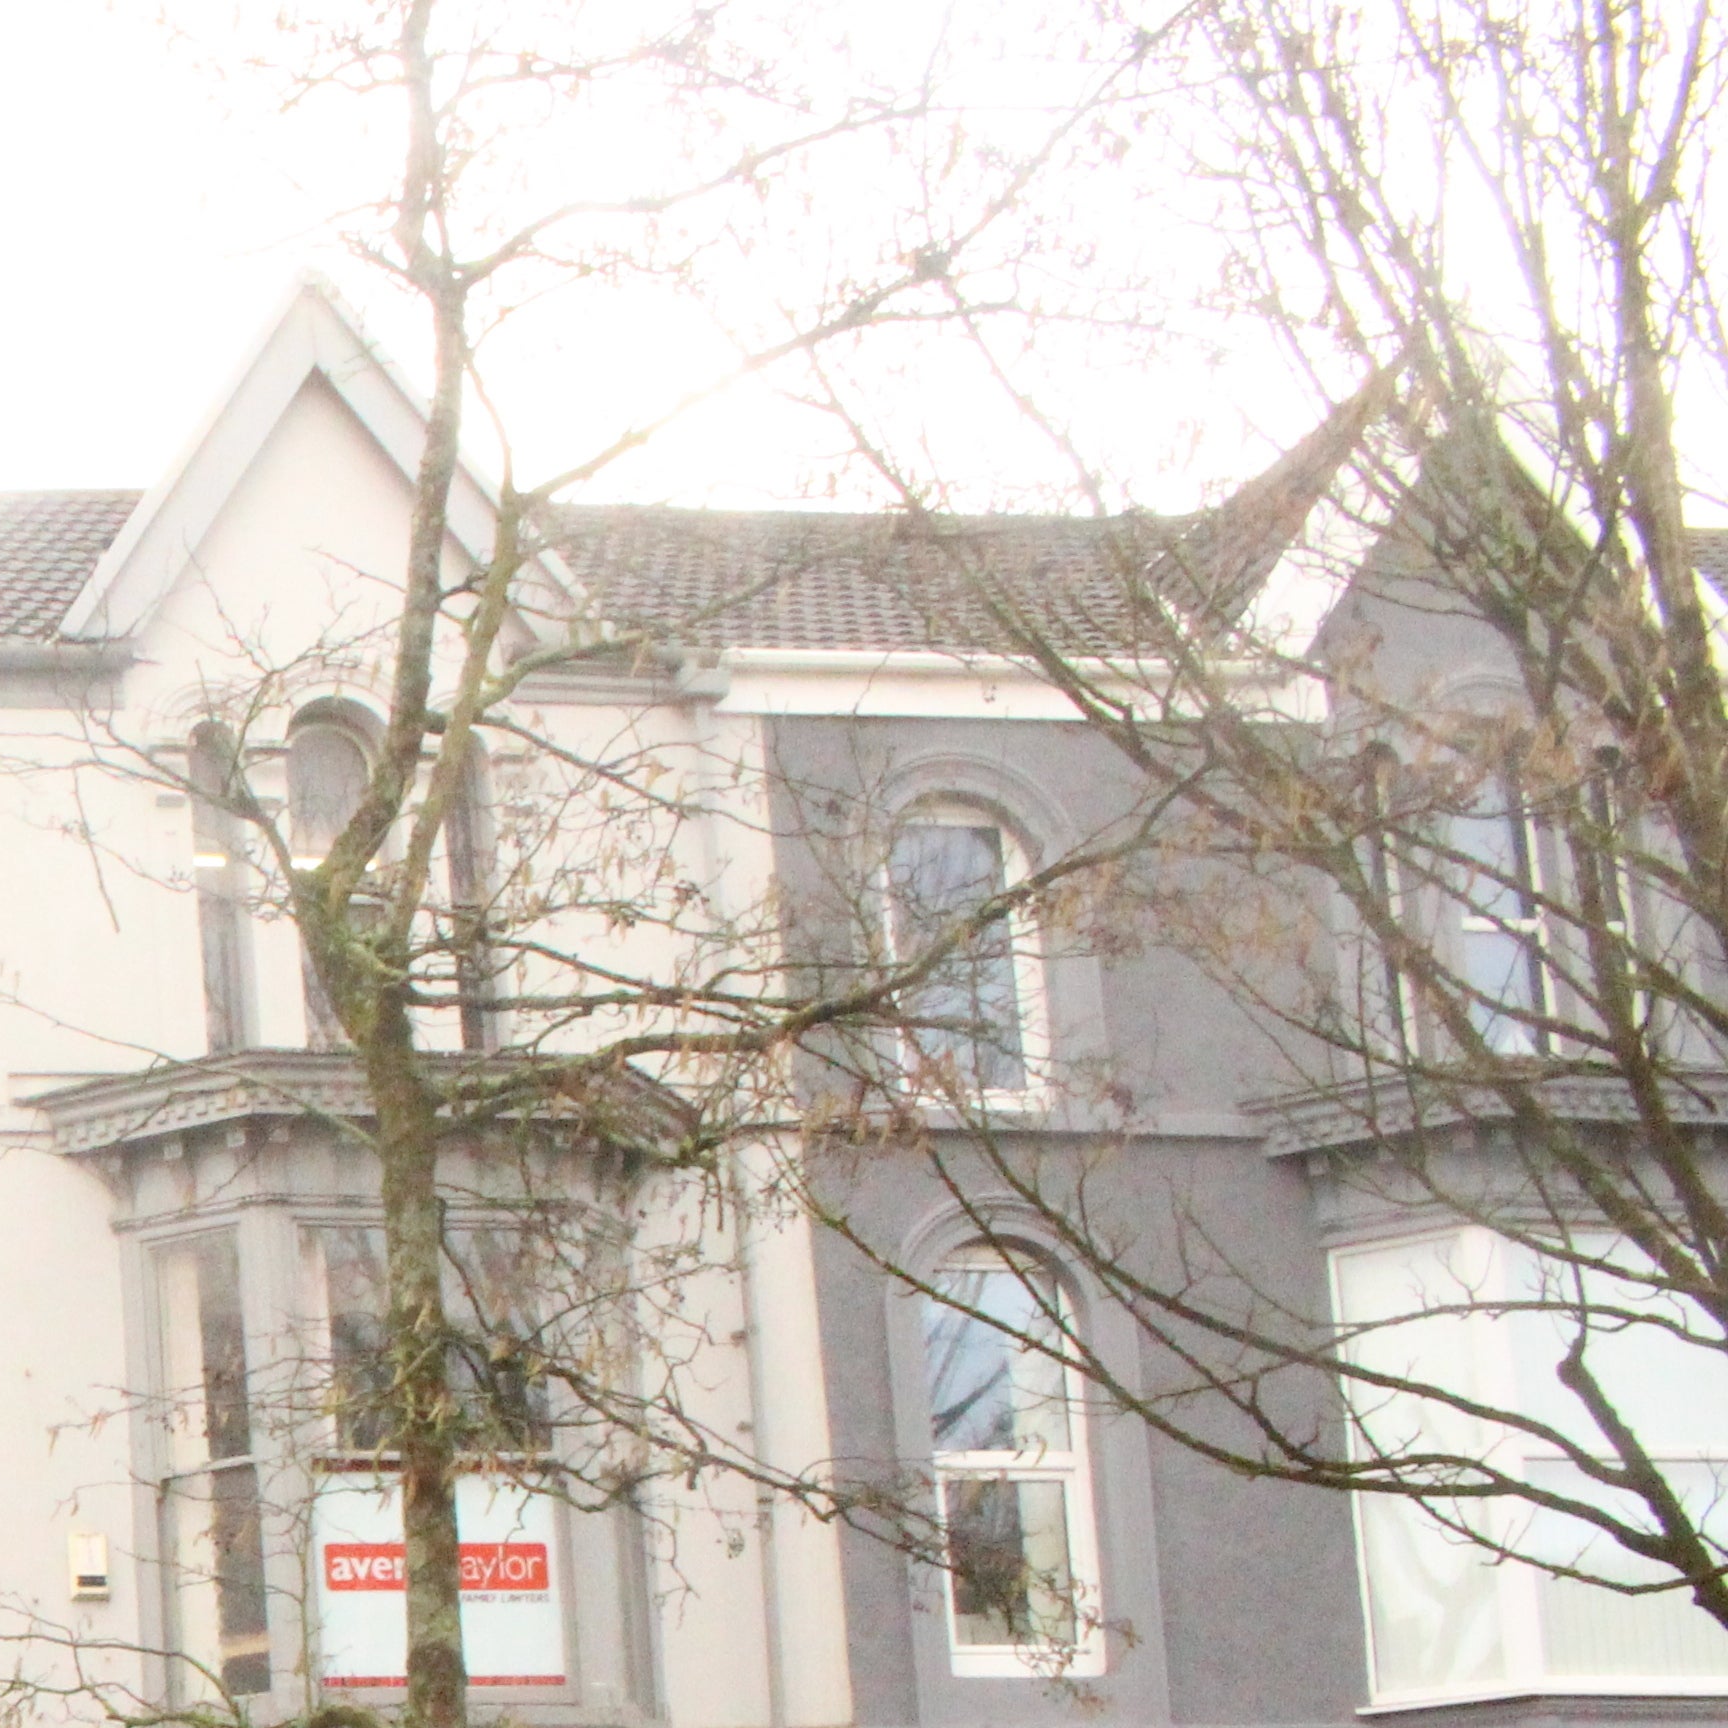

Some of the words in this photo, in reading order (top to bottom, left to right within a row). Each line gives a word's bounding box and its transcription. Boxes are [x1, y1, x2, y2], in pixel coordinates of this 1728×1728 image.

[331, 1555, 406, 1581] aver
[461, 1546, 542, 1587] aylor
[461, 1593, 497, 1603] FAMILY
[501, 1593, 550, 1603] LAWYERS
